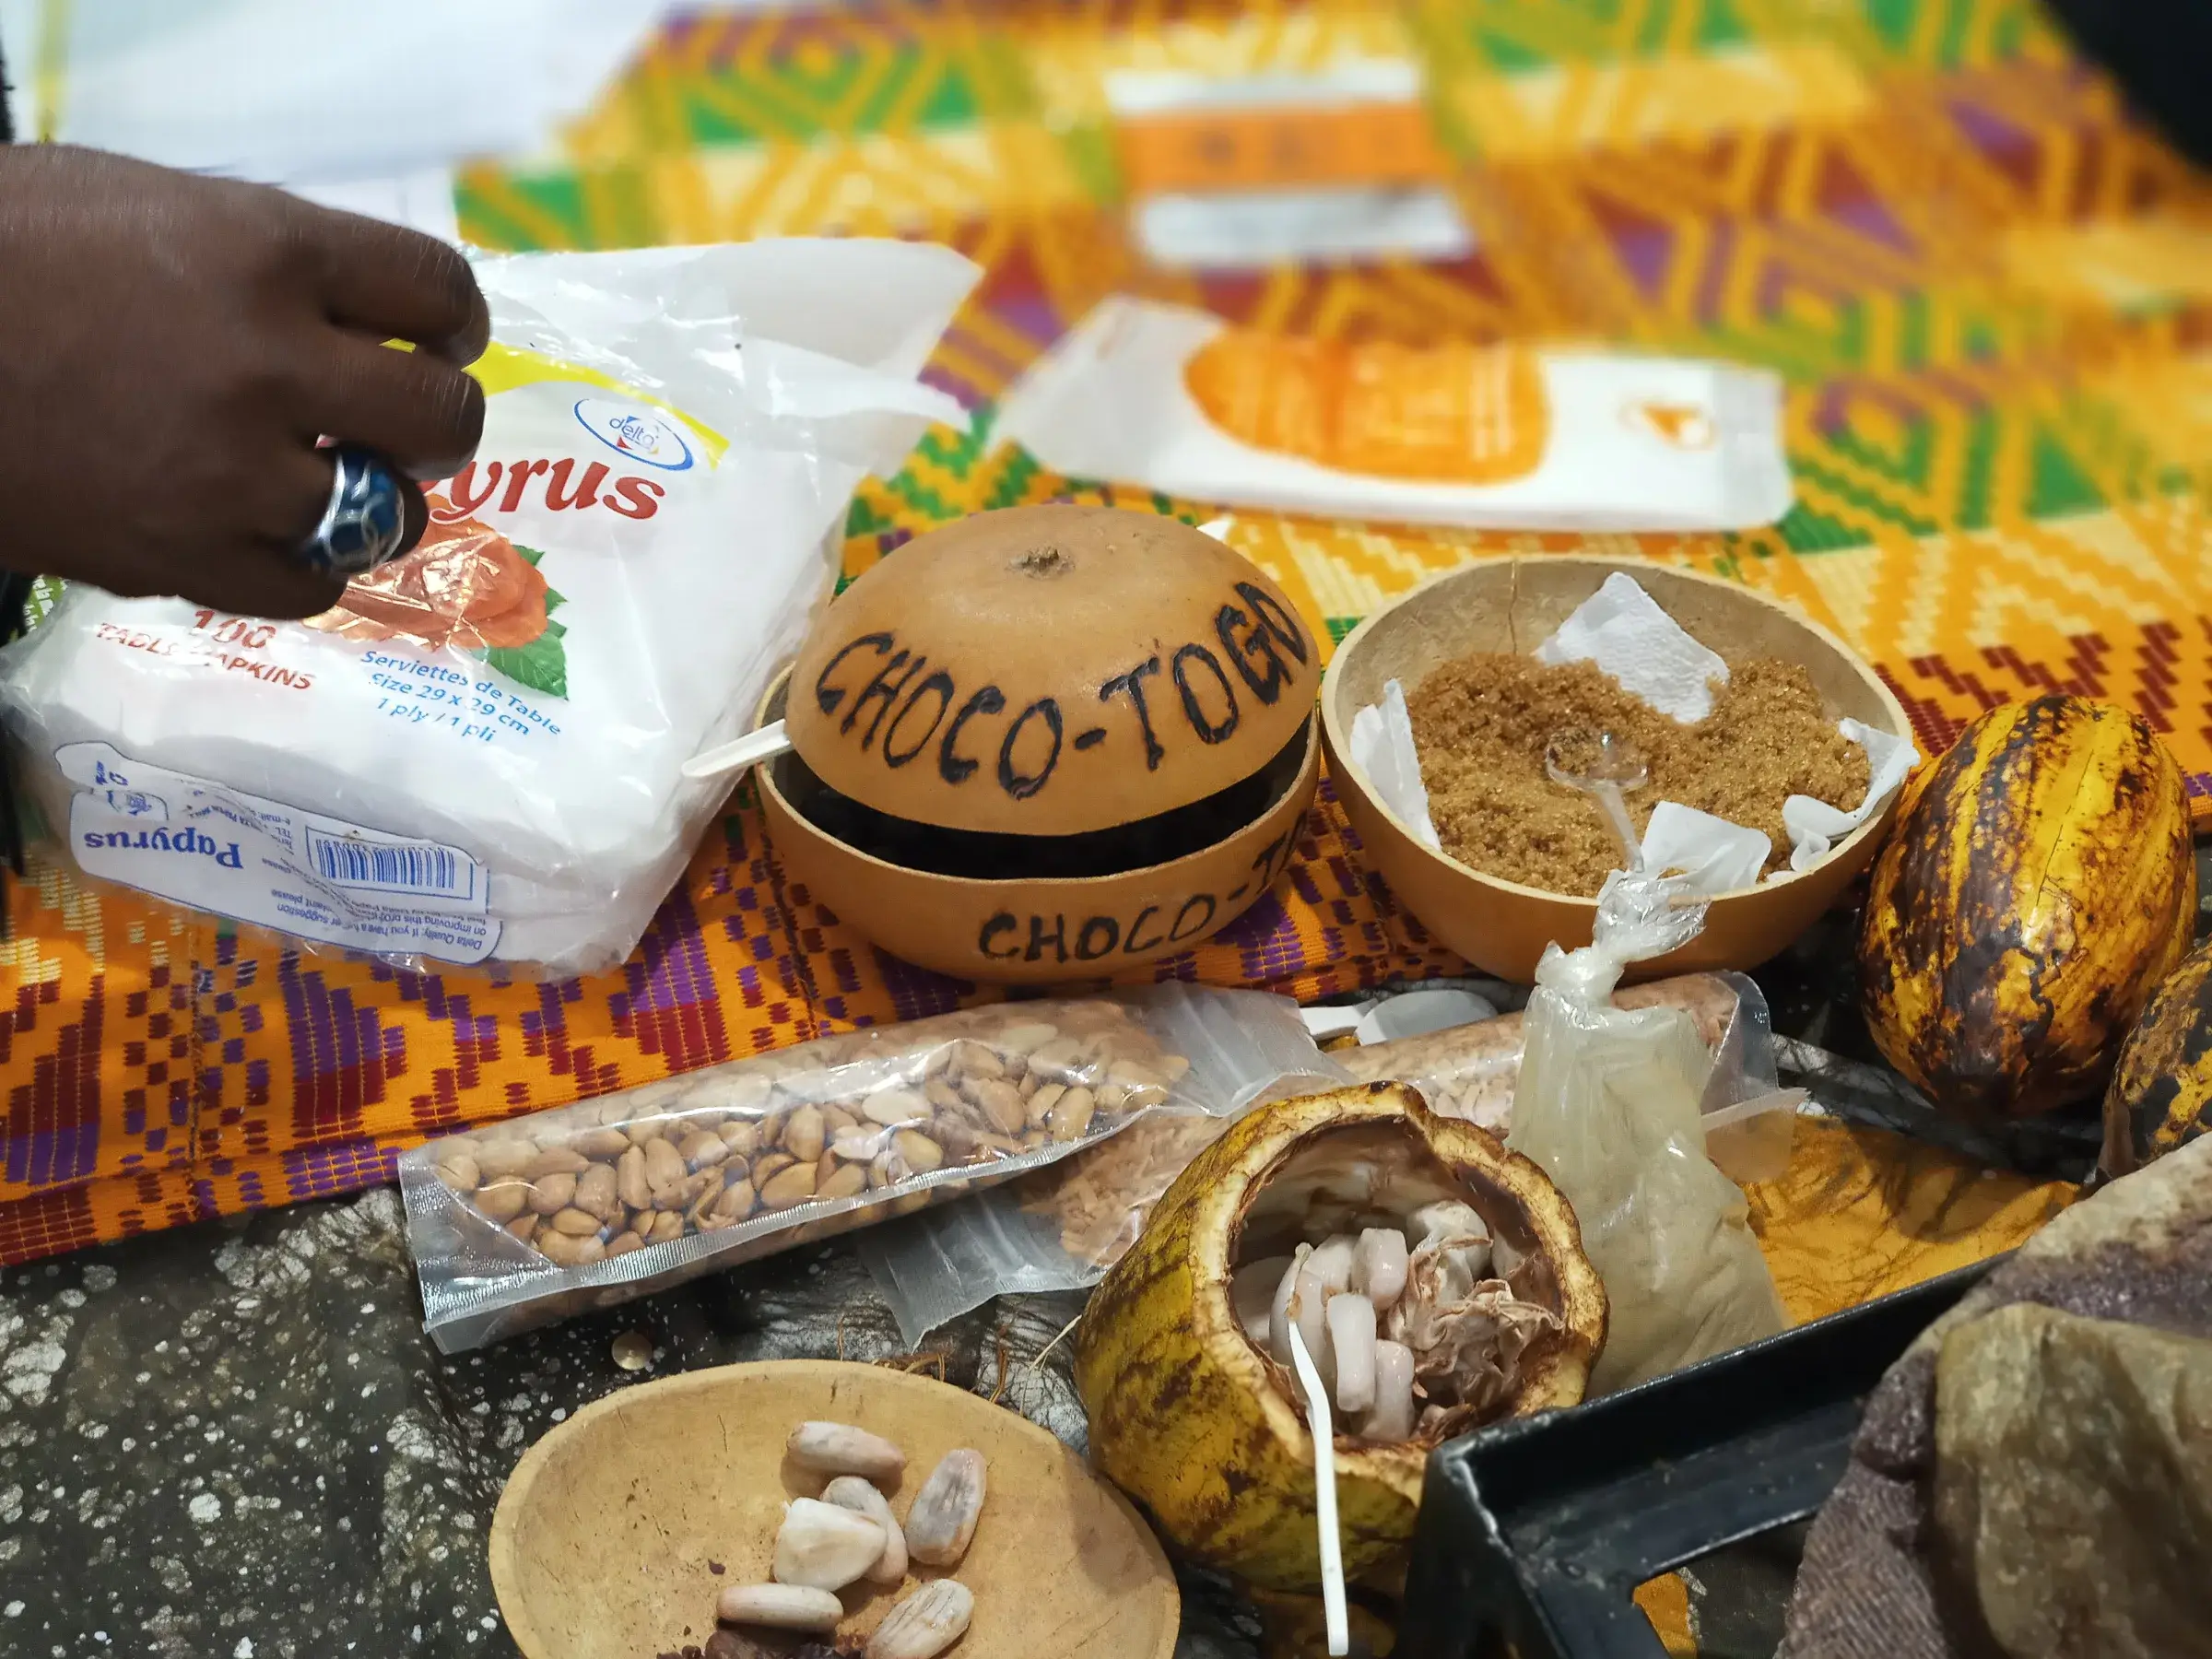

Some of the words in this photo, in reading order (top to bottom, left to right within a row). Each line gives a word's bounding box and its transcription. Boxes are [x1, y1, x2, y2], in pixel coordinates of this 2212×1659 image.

[609, 418, 655, 448] delta
[418, 457, 666, 520] yrus
[190, 609, 276, 649] 100
[188, 643, 316, 689] APKINS
[360, 651, 468, 686] Serviettes
[476, 680, 503, 700] de
[507, 694, 561, 735] Table
[815, 581, 1308, 802] CHOCO-TOGO
[377, 698, 390, 709] 1
[390, 702, 429, 723] ply
[450, 717, 460, 726] 1
[462, 723, 497, 742] pli
[417, 685, 446, 700] 29
[448, 693, 462, 706] x
[465, 698, 496, 715] 29
[499, 713, 529, 735] cm
[84, 827, 243, 869] Papyrus
[271, 889, 302, 905] please
[276, 904, 328, 924] suggestion
[404, 915, 421, 925] this
[424, 915, 471, 934] improving
[367, 924, 388, 936] have
[391, 925, 409, 935] you
[456, 936, 482, 950] Delta
[474, 927, 486, 936] on
